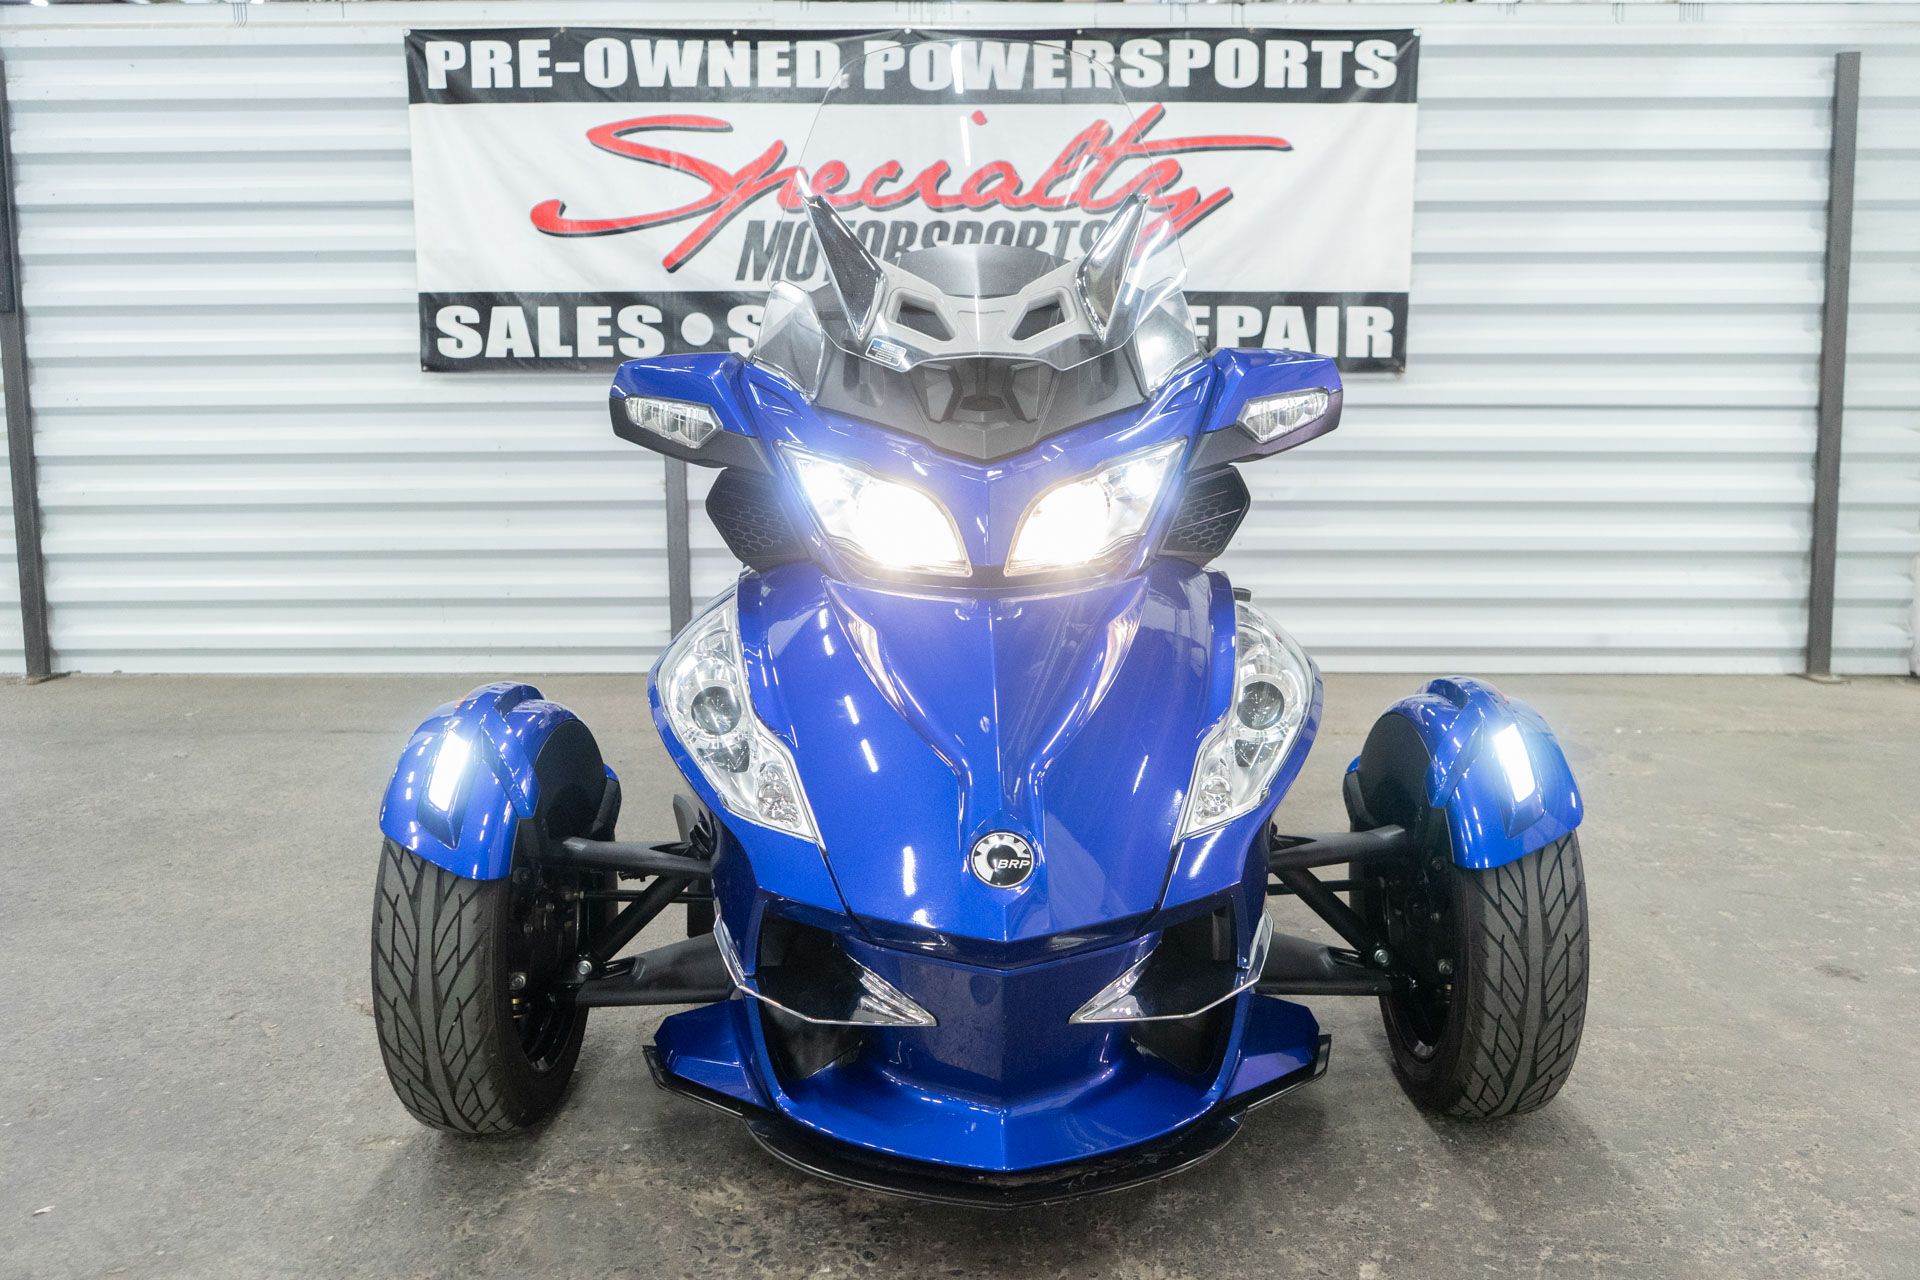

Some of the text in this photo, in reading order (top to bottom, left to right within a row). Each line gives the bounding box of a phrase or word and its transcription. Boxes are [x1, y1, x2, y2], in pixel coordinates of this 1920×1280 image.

[425, 38, 1398, 90] PRE-OWNED POWERSPORTS
[530, 103, 1293, 273] Specialty
[735, 219, 1109, 282] MOORSRT
[435, 305, 665, 358] SALES
[997, 859, 1031, 869] BRP
